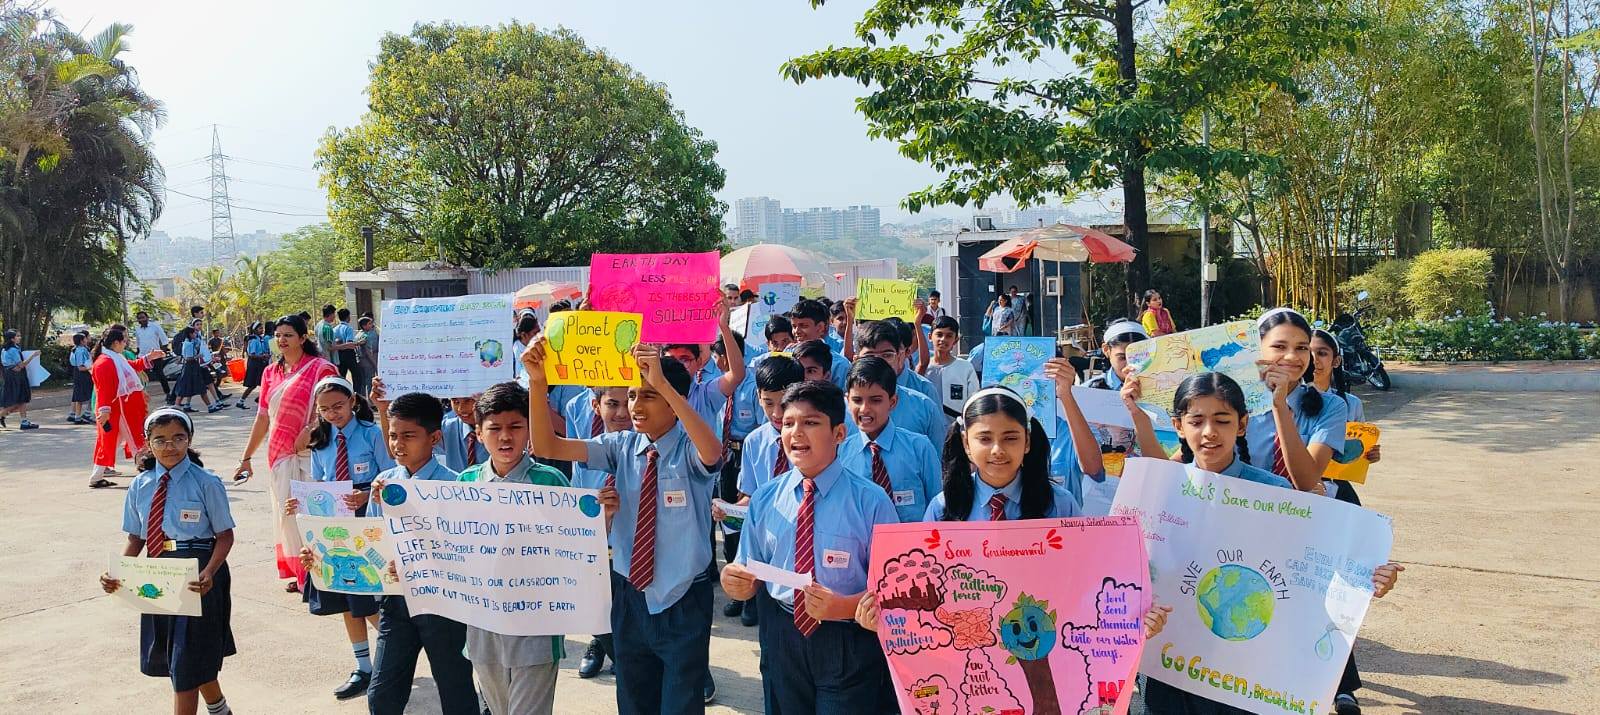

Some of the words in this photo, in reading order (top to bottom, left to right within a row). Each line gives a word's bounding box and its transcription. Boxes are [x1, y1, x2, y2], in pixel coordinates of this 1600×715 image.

[612, 256, 656, 269] EARTH
[664, 256, 689, 266] DAY
[641, 274, 666, 283] LESS
[648, 292, 660, 301] IS
[870, 284, 885, 294] Think
[891, 284, 908, 294] Green
[652, 308, 718, 324] SOLUTION
[870, 304, 884, 314] Live
[567, 315, 610, 336] Planet
[577, 345, 602, 355] over
[1026, 343, 1048, 359] DAY
[573, 358, 613, 380] Profit
[415, 484, 492, 502] WORLDS
[498, 488, 544, 506] EARTH
[550, 491, 577, 508] DAY
[389, 515, 432, 534] LESS
[437, 516, 500, 536] POLLUTION
[505, 523, 515, 534] IS
[517, 523, 532, 533] THE
[535, 524, 554, 534] BEST
[559, 525, 596, 536] SOLUTION
[397, 539, 427, 555] LIFE
[430, 540, 441, 549] IS
[480, 545, 497, 554] ONLY
[502, 547, 515, 556] ON
[521, 546, 550, 556] EARTH
[555, 548, 583, 560] PROTECT
[587, 554, 597, 563] IT
[945, 540, 972, 560] Save
[402, 552, 428, 566] FROM
[405, 569, 430, 582] SAVE
[431, 570, 445, 579] THE
[488, 578, 503, 587] OUR
[509, 577, 560, 587] CLASSROOM
[563, 576, 577, 586] TOO
[1180, 561, 1203, 596] SAVE
[1216, 549, 1244, 564] OUR
[1259, 559, 1291, 600] EARTH
[549, 601, 576, 611] EARTH
[1161, 642, 1185, 672] Go
